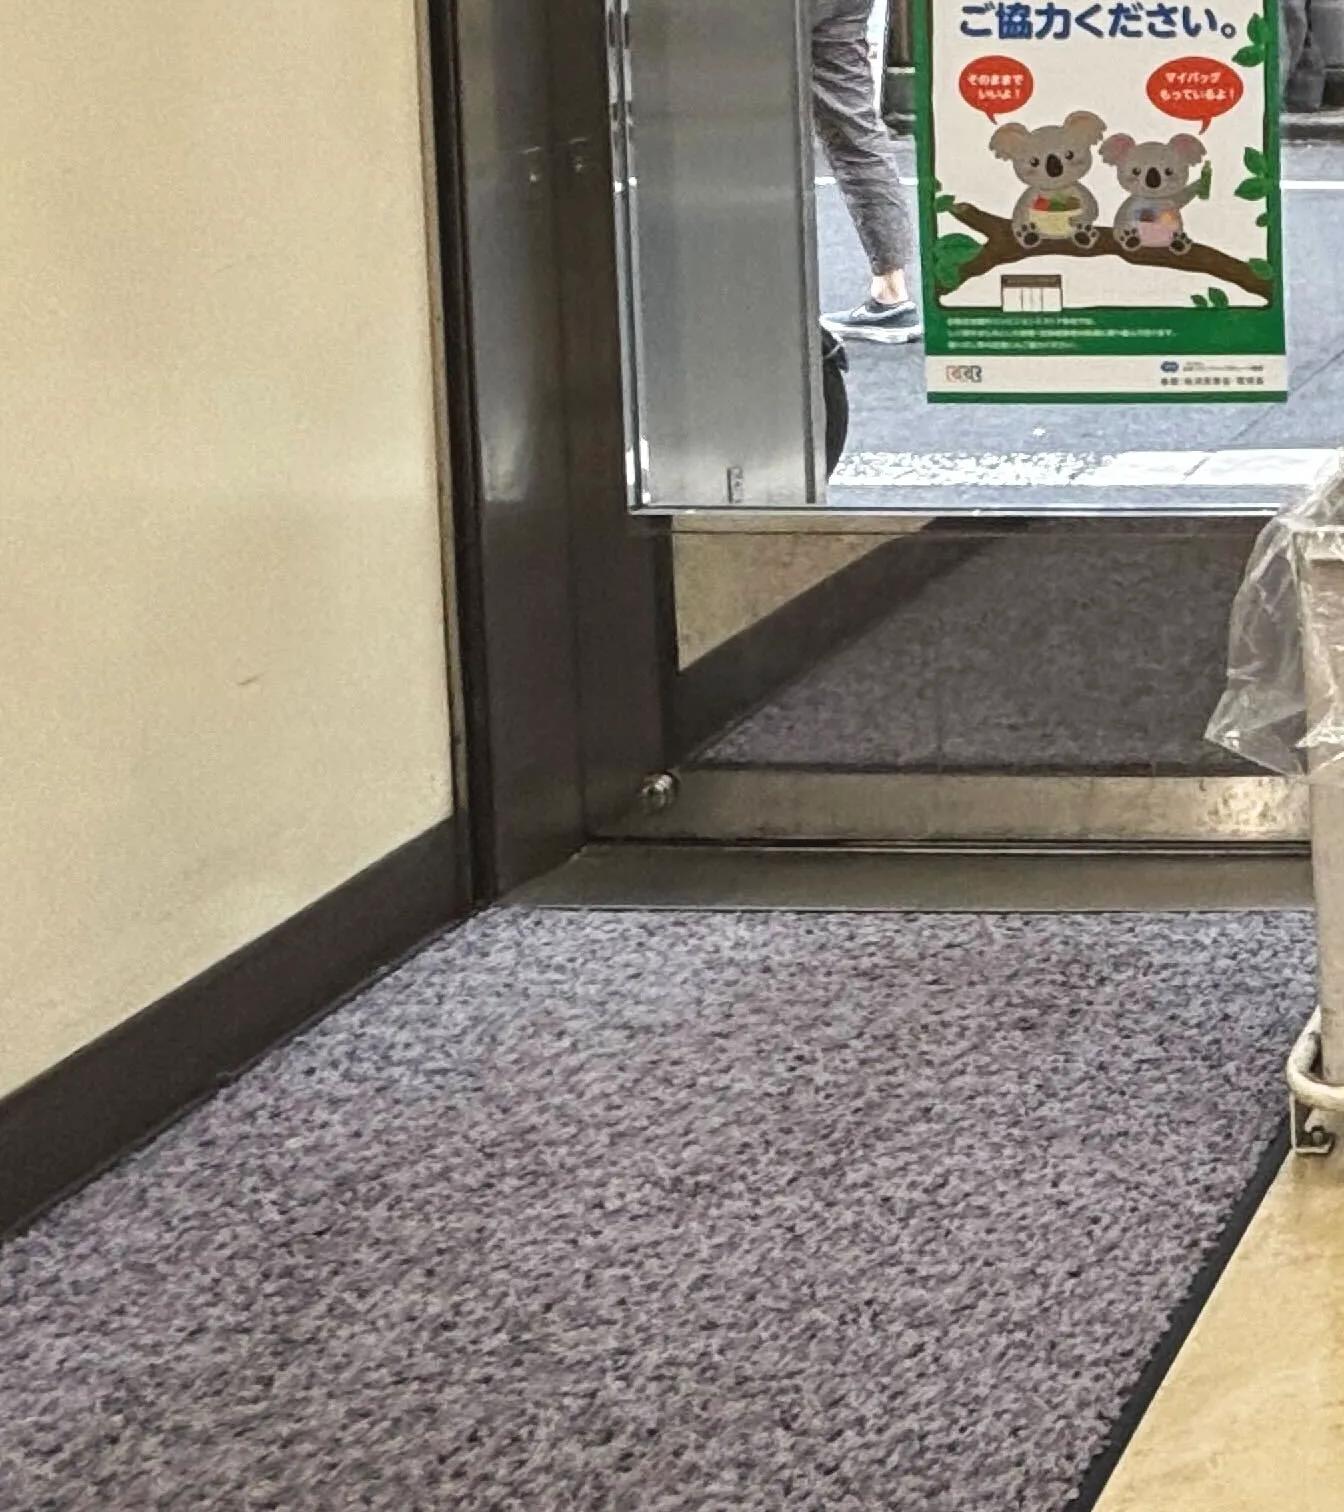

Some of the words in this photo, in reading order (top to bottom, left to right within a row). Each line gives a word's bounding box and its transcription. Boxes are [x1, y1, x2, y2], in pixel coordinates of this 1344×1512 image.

[960, 1, 1237, 40] ご協力ください。
